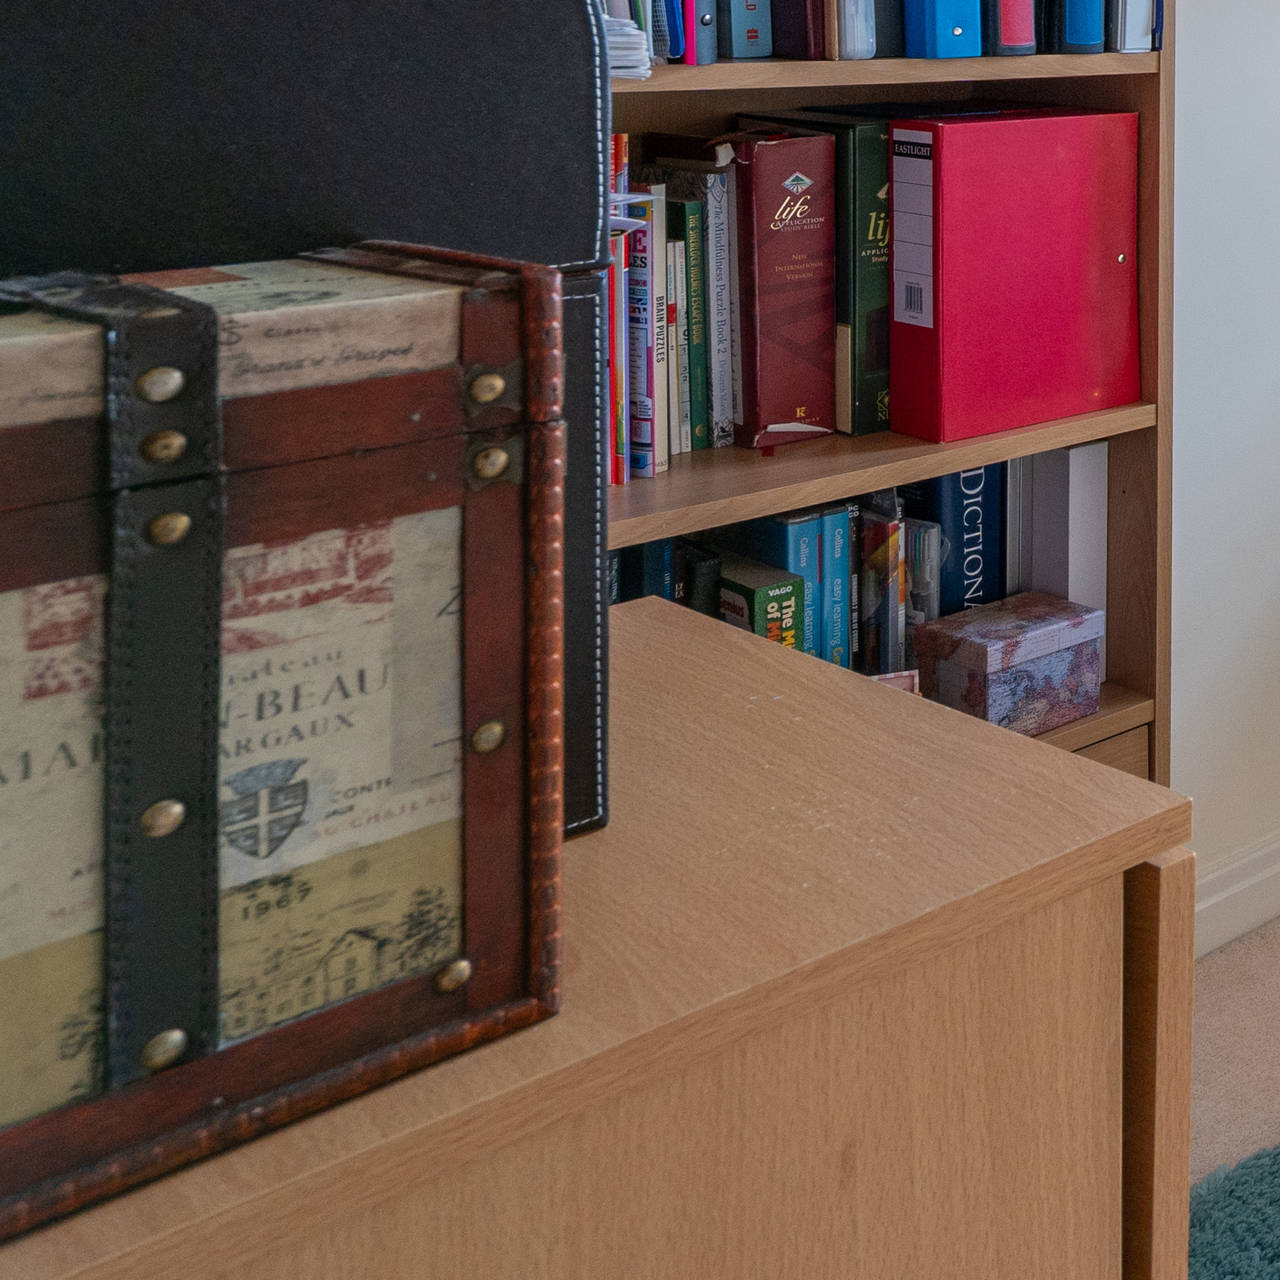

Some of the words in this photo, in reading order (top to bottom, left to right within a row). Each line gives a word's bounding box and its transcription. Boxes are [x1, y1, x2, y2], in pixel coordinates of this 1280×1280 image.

[895, 143, 932, 157] EASTLIGHT
[770, 194, 811, 231] life
[775, 216, 825, 227] APPLICATION
[716, 221, 727, 282] Mindfulness
[655, 295, 665, 323] BRAIN
[692, 297, 702, 322] ESCAPE
[717, 284, 727, 318] Puzzle
[656, 325, 666, 363] PUZZLES
[717, 320, 728, 345] Book
[799, 537, 808, 568] Collins
[834, 528, 843, 559] Collins
[804, 581, 813, 604] easy
[831, 577, 842, 601] easy
[782, 595, 796, 629] The
[804, 606, 815, 649] learning
[831, 602, 843, 646] learning
